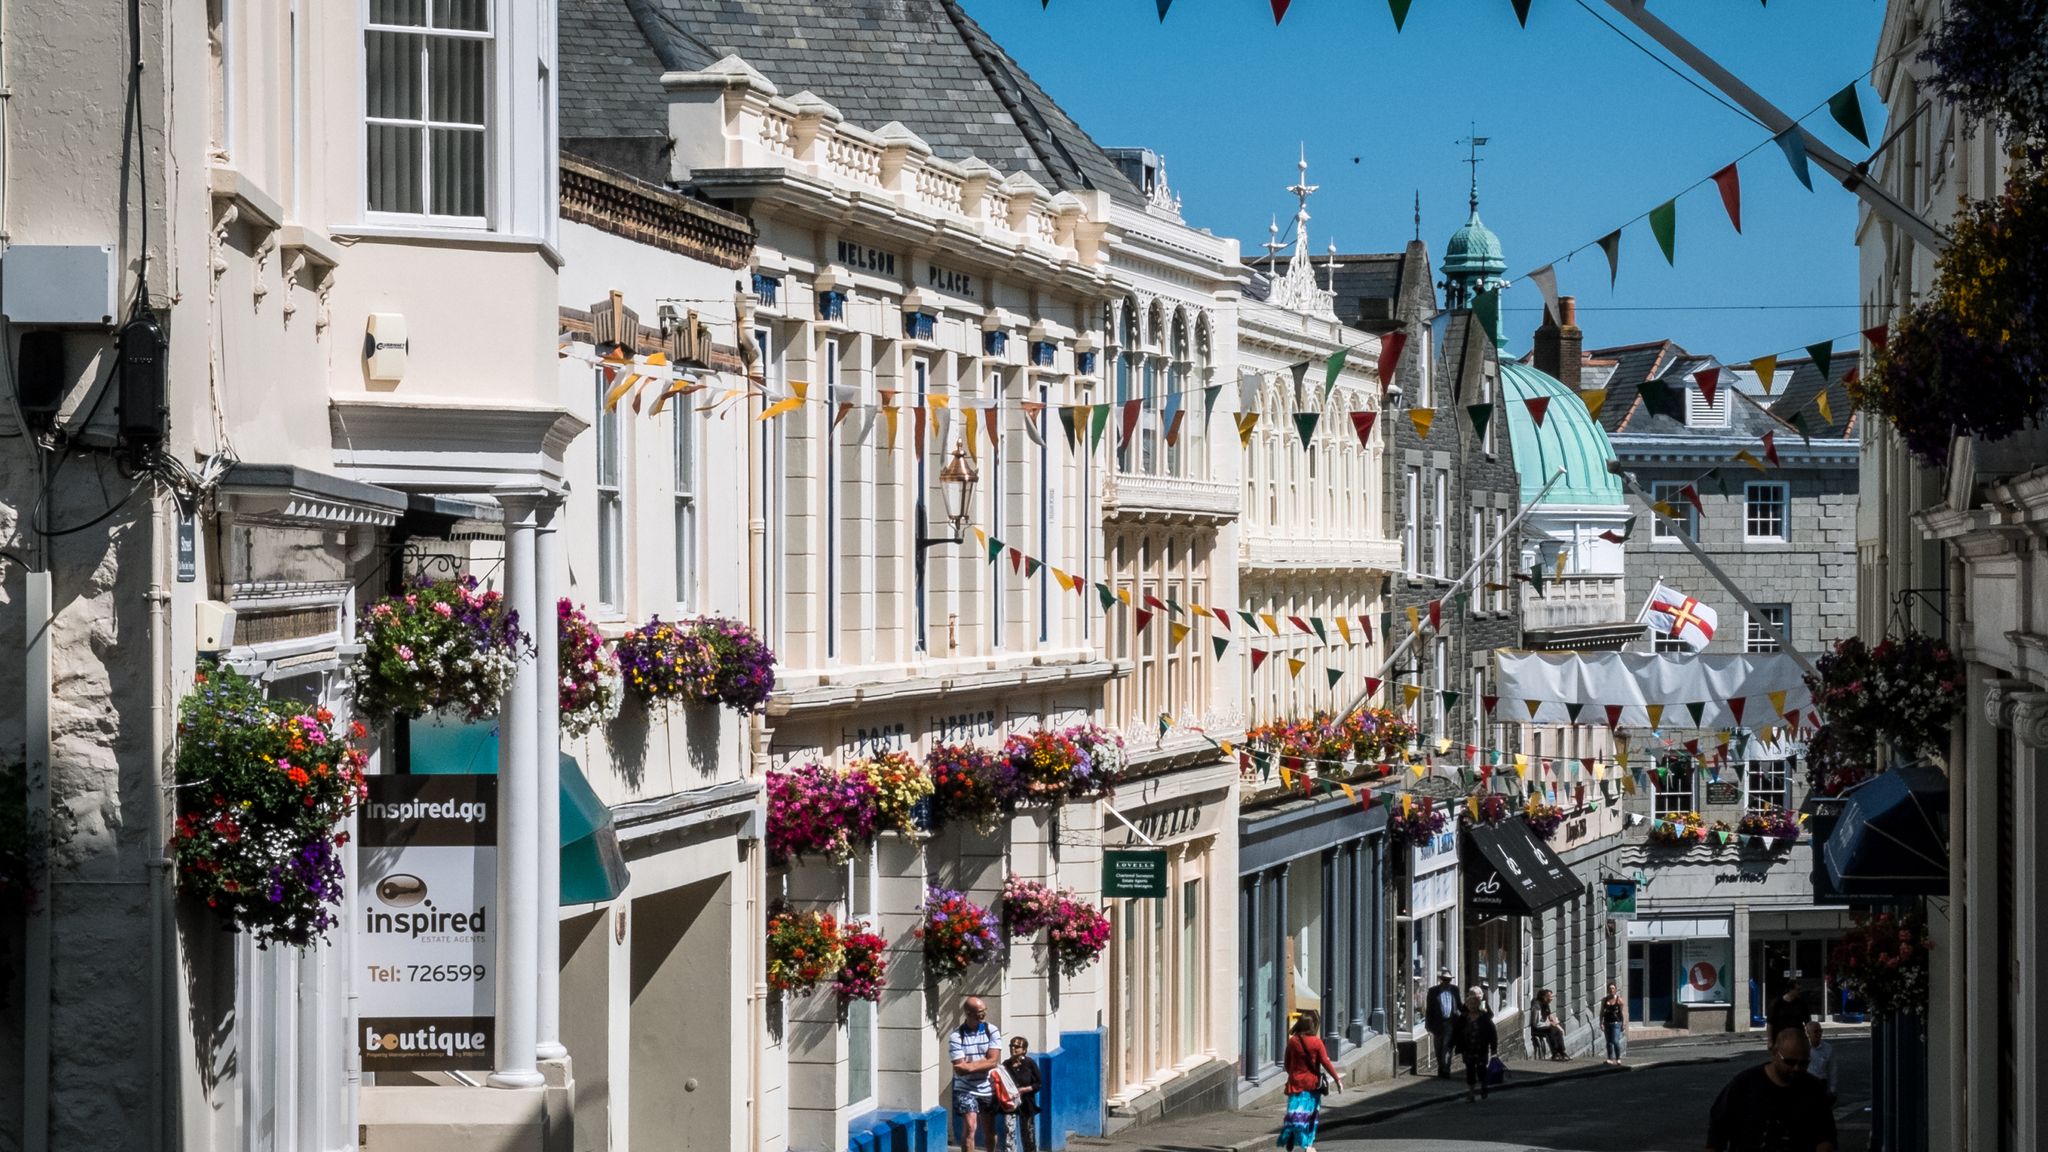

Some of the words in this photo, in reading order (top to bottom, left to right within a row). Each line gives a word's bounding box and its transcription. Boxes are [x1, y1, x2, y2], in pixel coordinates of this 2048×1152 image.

[838, 240, 894, 275] NELSON
[929, 265, 974, 297] PLACE.
[858, 723, 904, 757] POST
[940, 711, 994, 743] OFFICE
[367, 798, 486, 823] inspired.gg
[1126, 801, 1202, 846] LOVELLS
[1475, 871, 1500, 894] ab
[1715, 872, 1768, 885] pharmacy
[367, 906, 486, 939] inspired
[367, 965, 400, 982] Tel:
[407, 964, 486, 982] 726599
[366, 1025, 486, 1056] boutique
